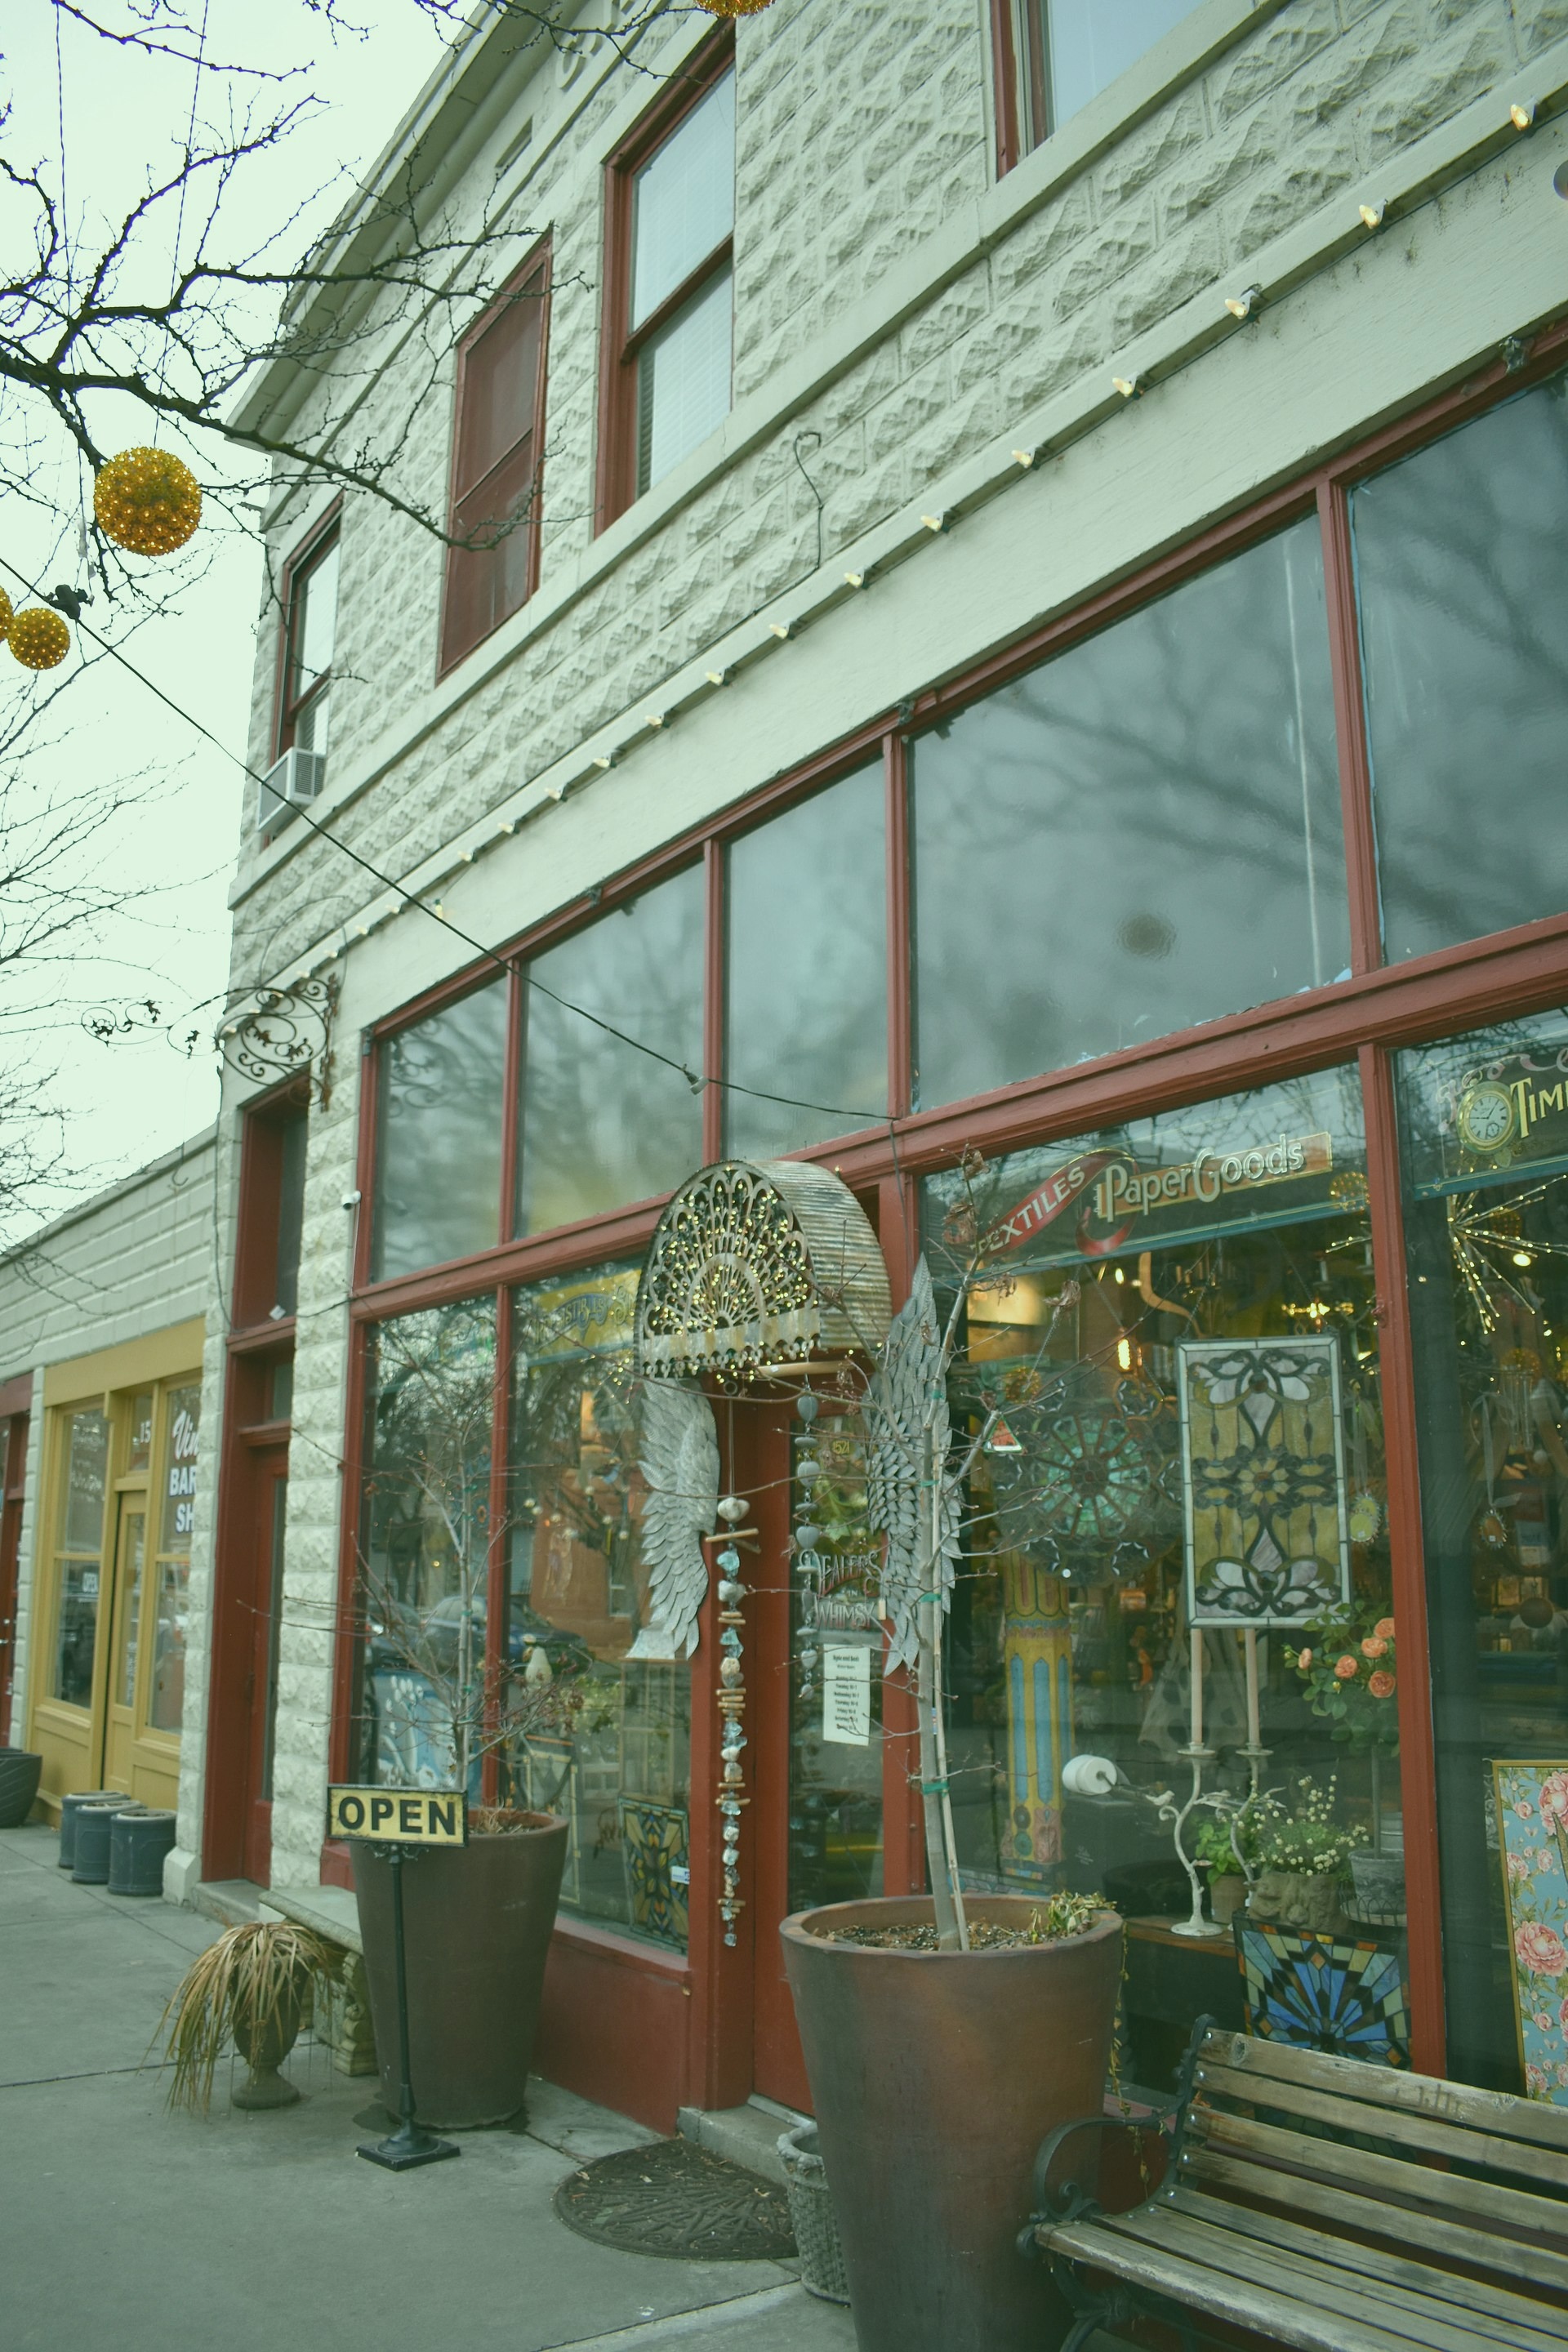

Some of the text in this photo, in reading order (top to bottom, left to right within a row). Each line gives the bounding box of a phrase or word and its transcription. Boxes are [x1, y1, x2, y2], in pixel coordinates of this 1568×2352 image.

[1510, 1076, 1568, 1139] TIM
[970, 1165, 1085, 1254] TEXTILES
[813, 1594, 875, 1630] WHIMSY
[338, 1796, 456, 1836] OPEN
